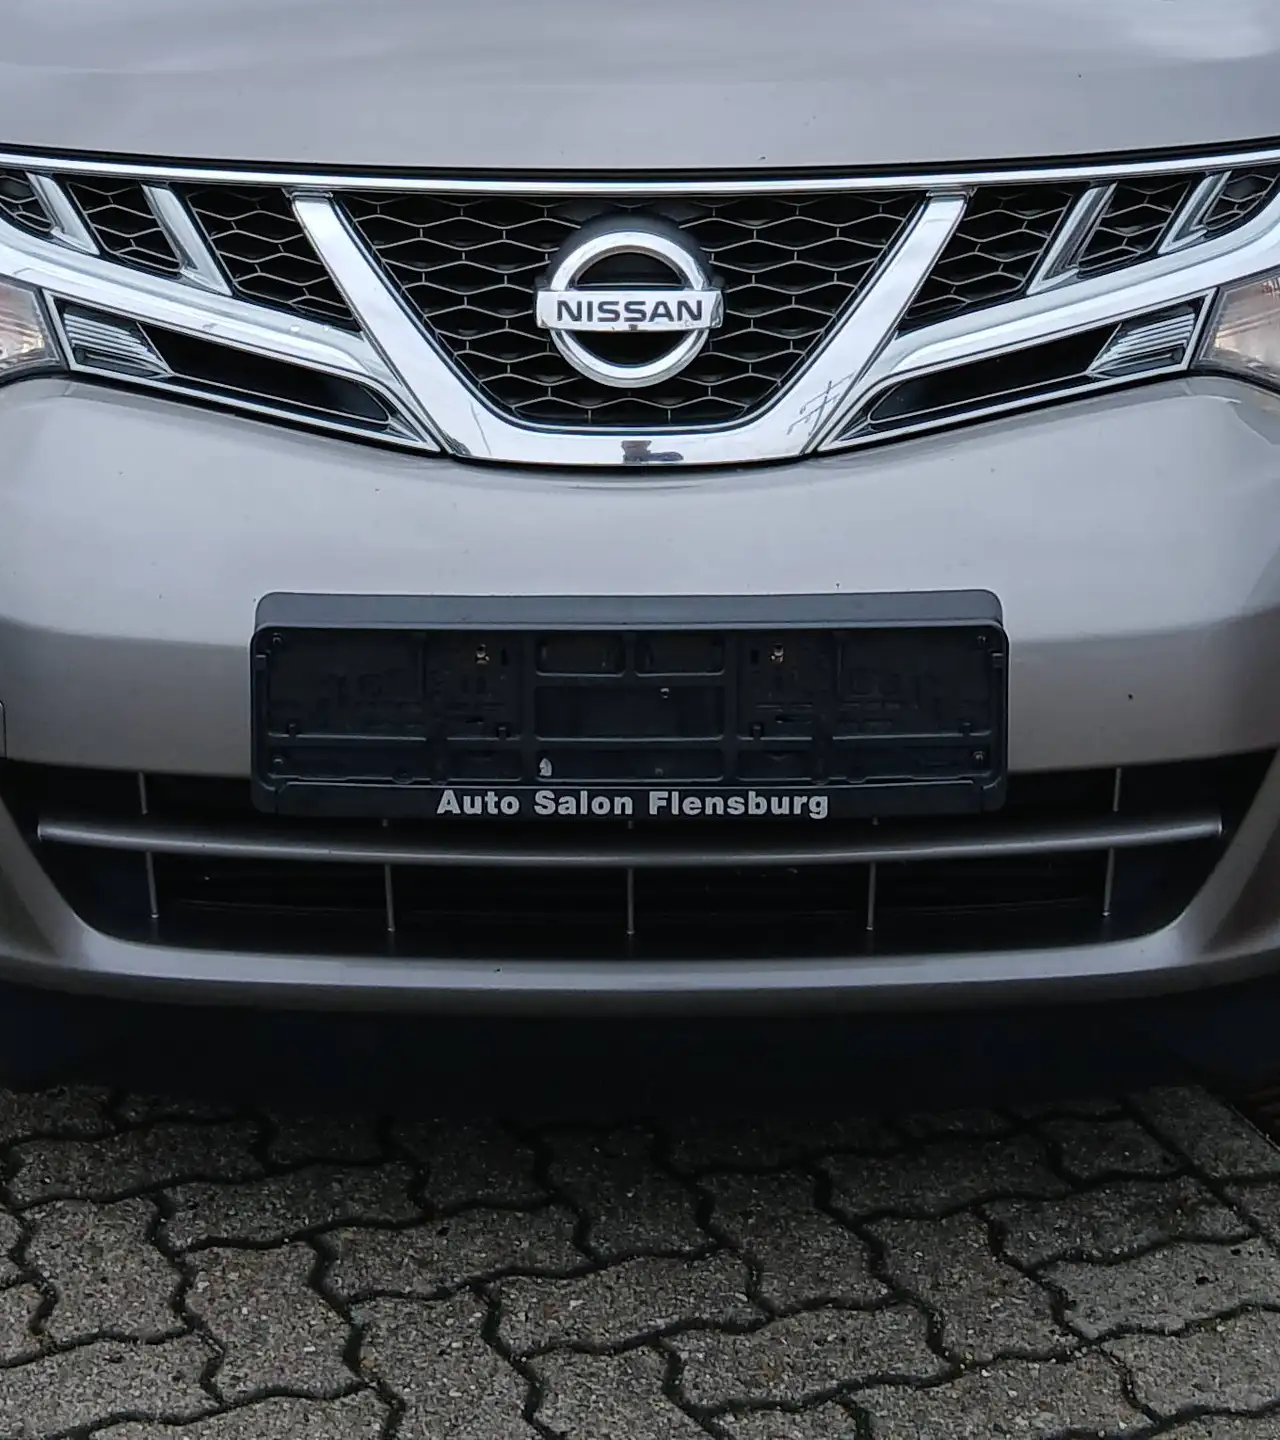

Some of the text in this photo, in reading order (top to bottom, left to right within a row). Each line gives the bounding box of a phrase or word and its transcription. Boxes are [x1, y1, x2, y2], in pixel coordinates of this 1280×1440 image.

[556, 299, 703, 323] NISSAN
[436, 788, 830, 820] Auto Salon Flensburg
